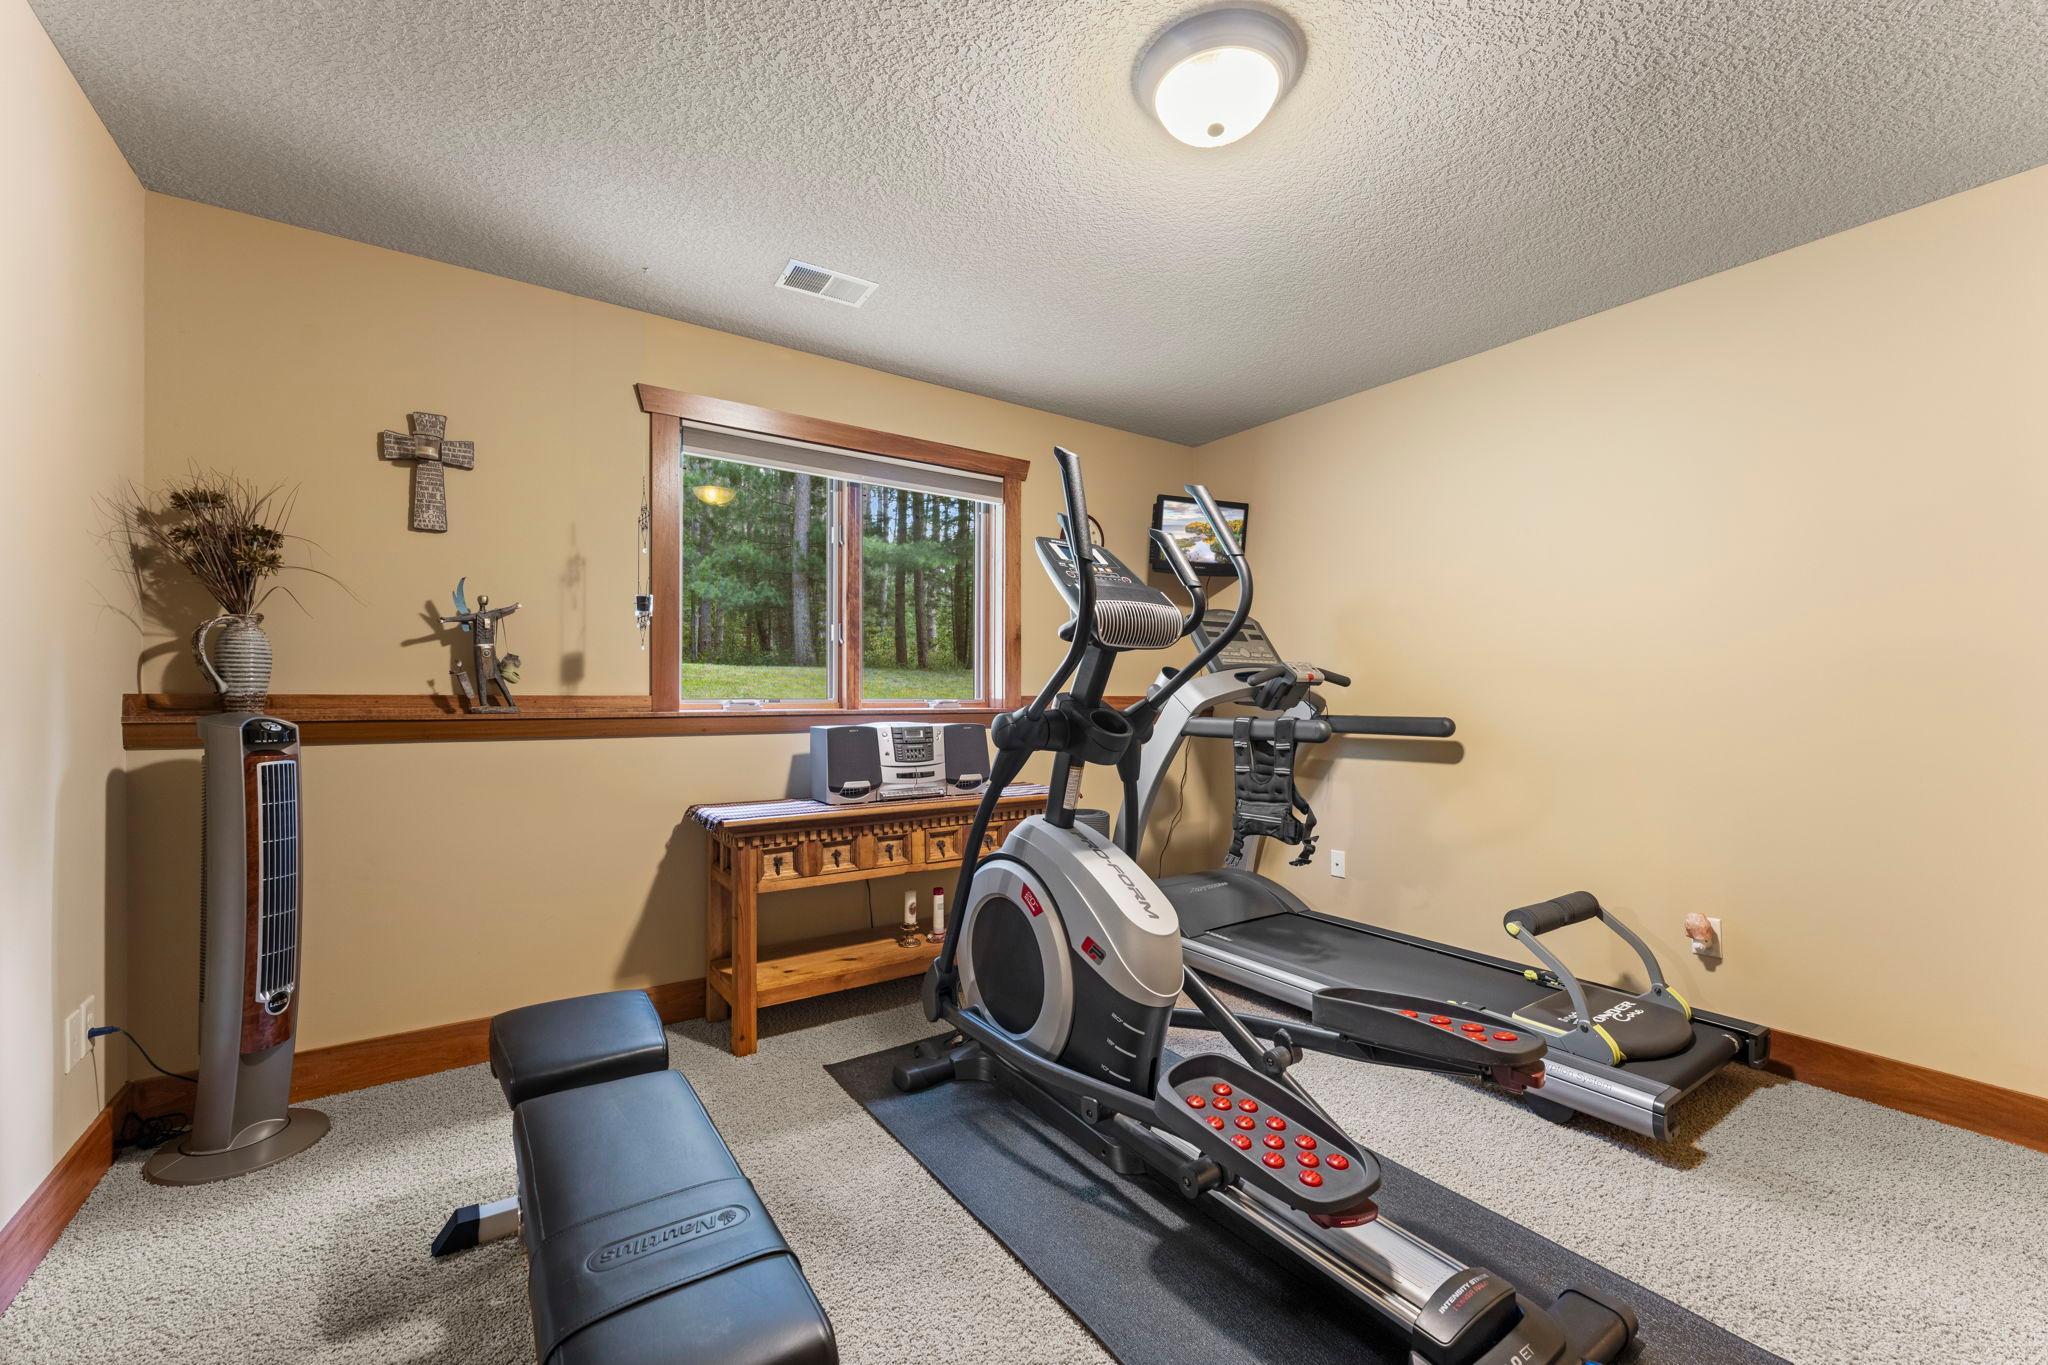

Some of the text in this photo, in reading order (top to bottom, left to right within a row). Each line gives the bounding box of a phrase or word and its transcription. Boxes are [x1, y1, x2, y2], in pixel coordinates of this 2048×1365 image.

[1071, 831, 1159, 919] PRO-FORM
[1573, 1001, 1637, 1024] ONDER
[600, 1214, 717, 1264] Nautilus
[1438, 1282, 1470, 1315] INTENSITY
[1519, 1343, 1535, 1361] ET
